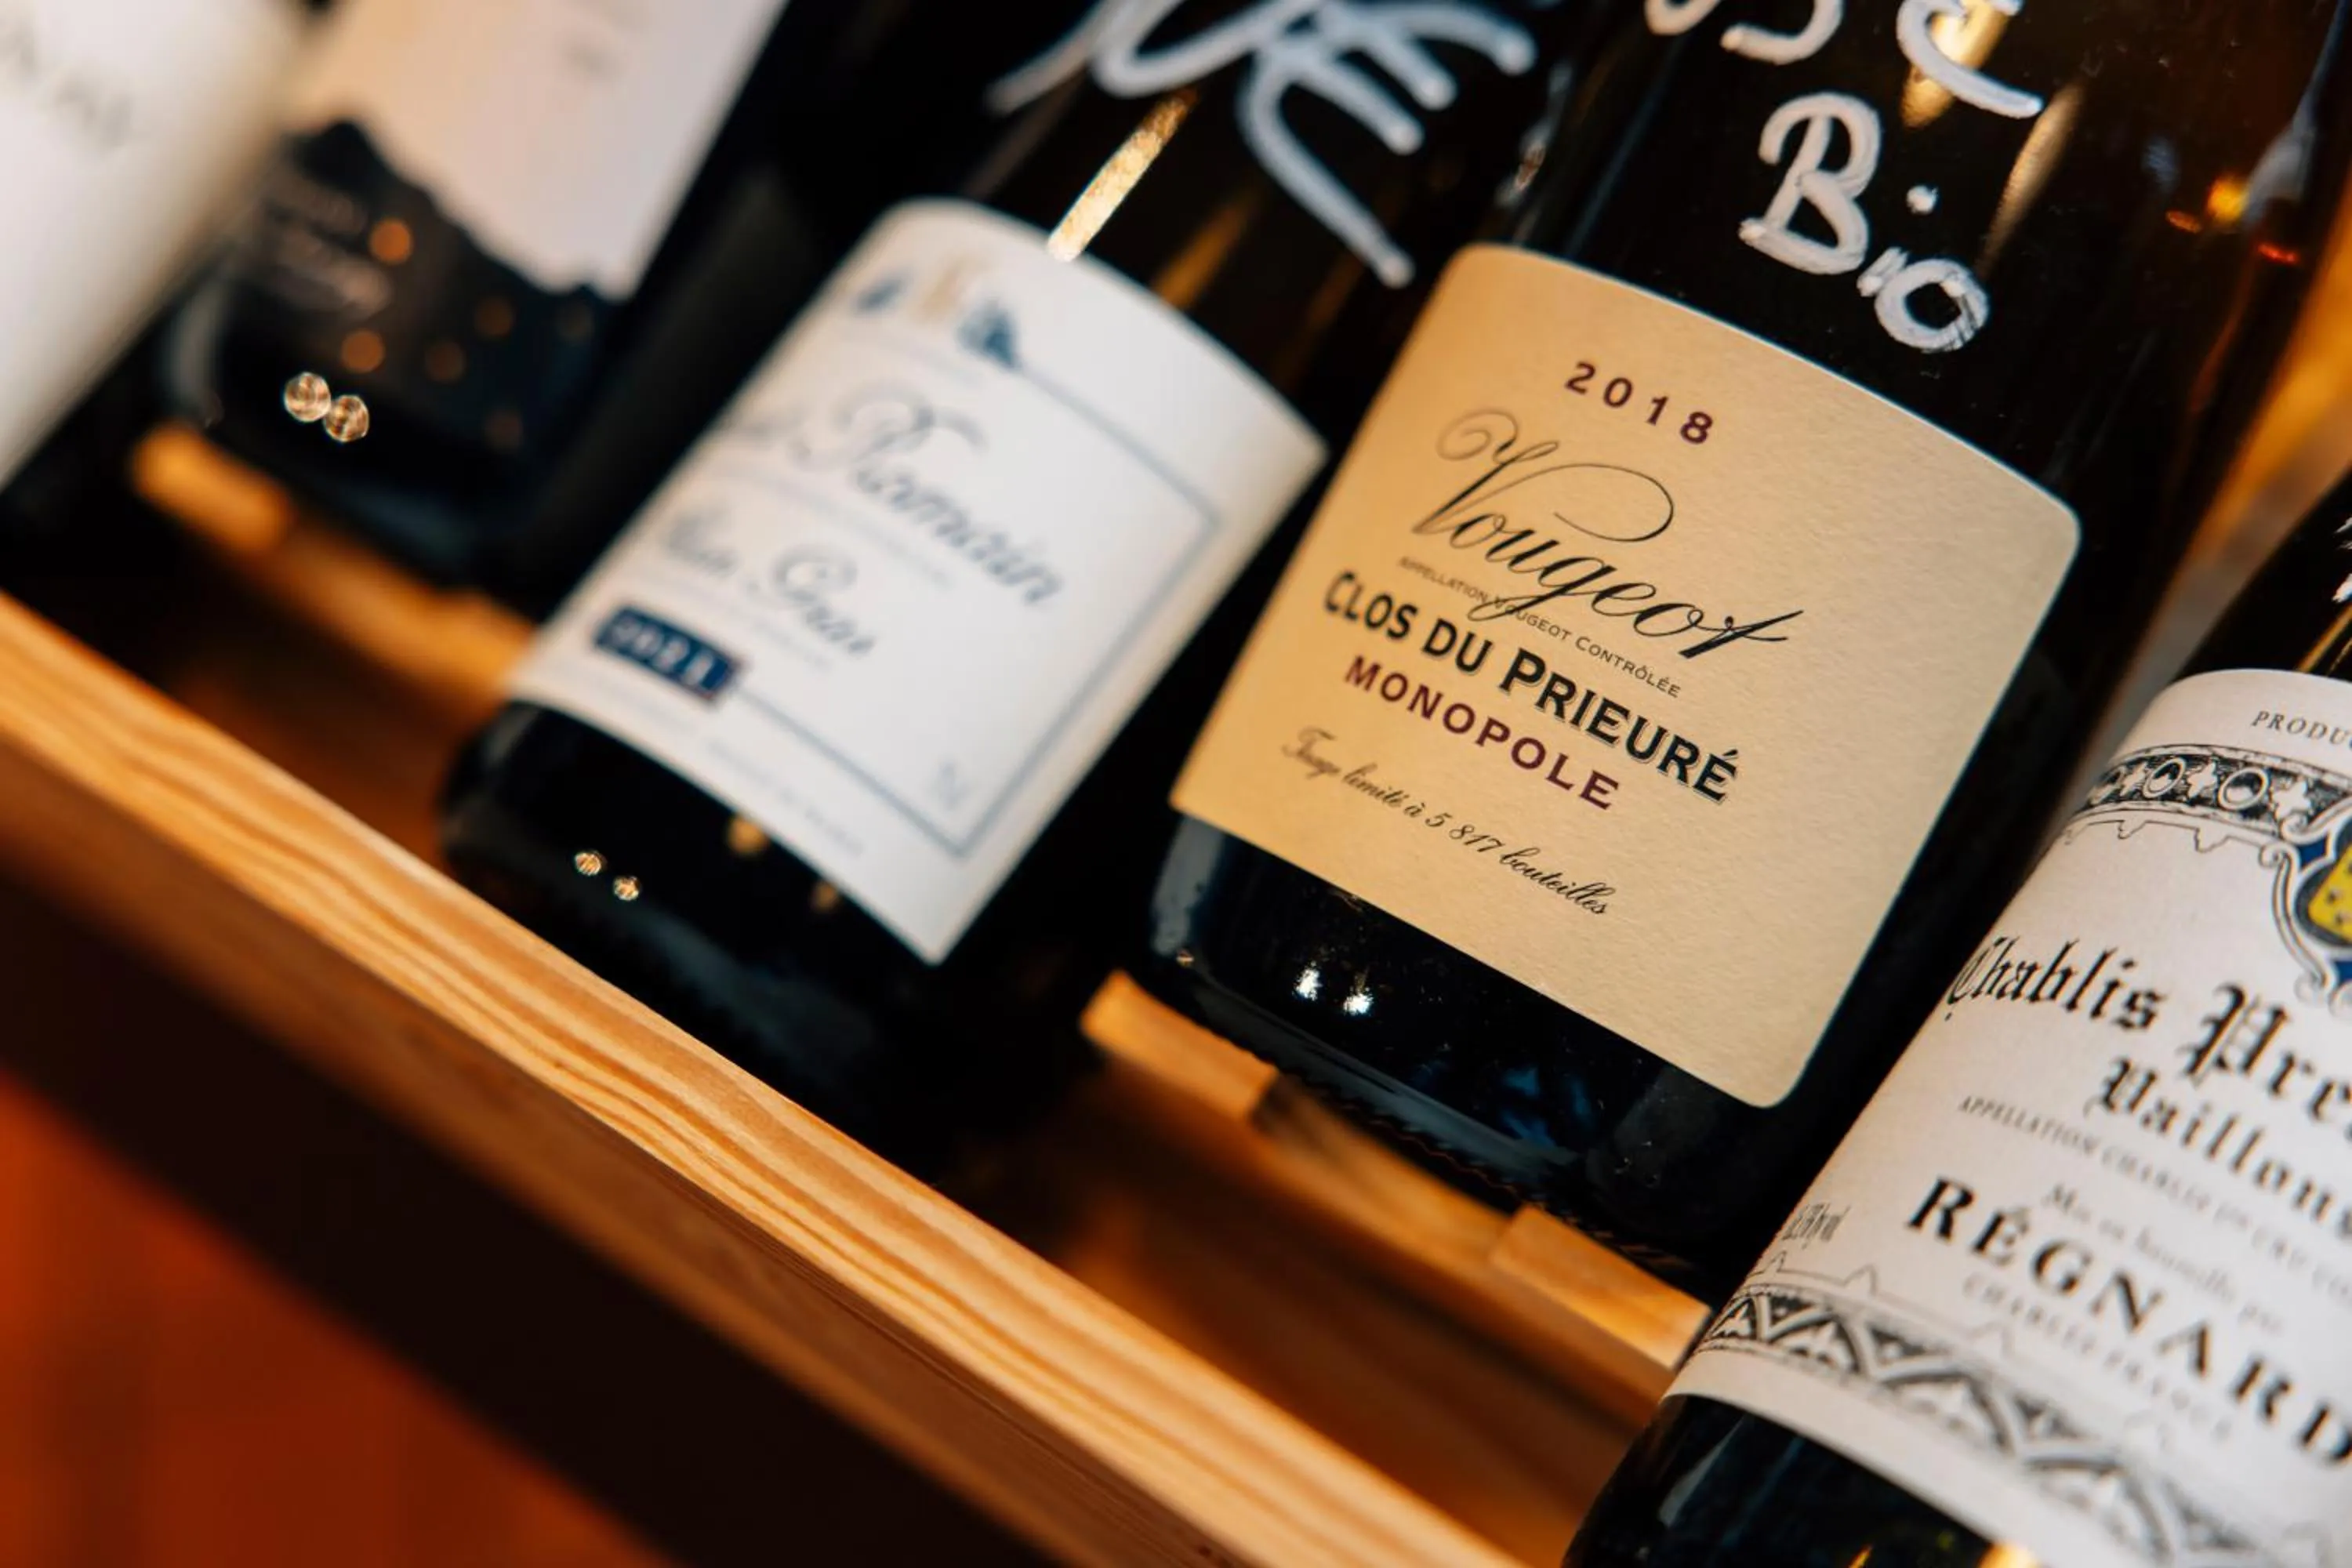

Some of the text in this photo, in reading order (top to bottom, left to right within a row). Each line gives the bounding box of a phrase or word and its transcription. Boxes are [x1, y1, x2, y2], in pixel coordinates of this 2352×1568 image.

[1564, 361, 1715, 445] 2018
[1411, 407, 1804, 659] Vougeot
[1322, 570, 1740, 804] CLOS DU PRIEURÉ
[1398, 555, 1489, 604] APPELLATION
[1574, 634, 1681, 699] CONTRÔLÉE
[1344, 655, 1622, 811] MONOPOLE
[1341, 762, 1403, 809] limité
[1403, 801, 1425, 818] à
[1425, 811, 1451, 829] 5
[1449, 823, 1505, 854] 817
[1499, 848, 1617, 916] bouteilles
[1944, 936, 2352, 1146] Chablis Pre
[1958, 1094, 2100, 1156] APPELLATION
[1904, 1174, 2352, 1468] RÉGNARD
